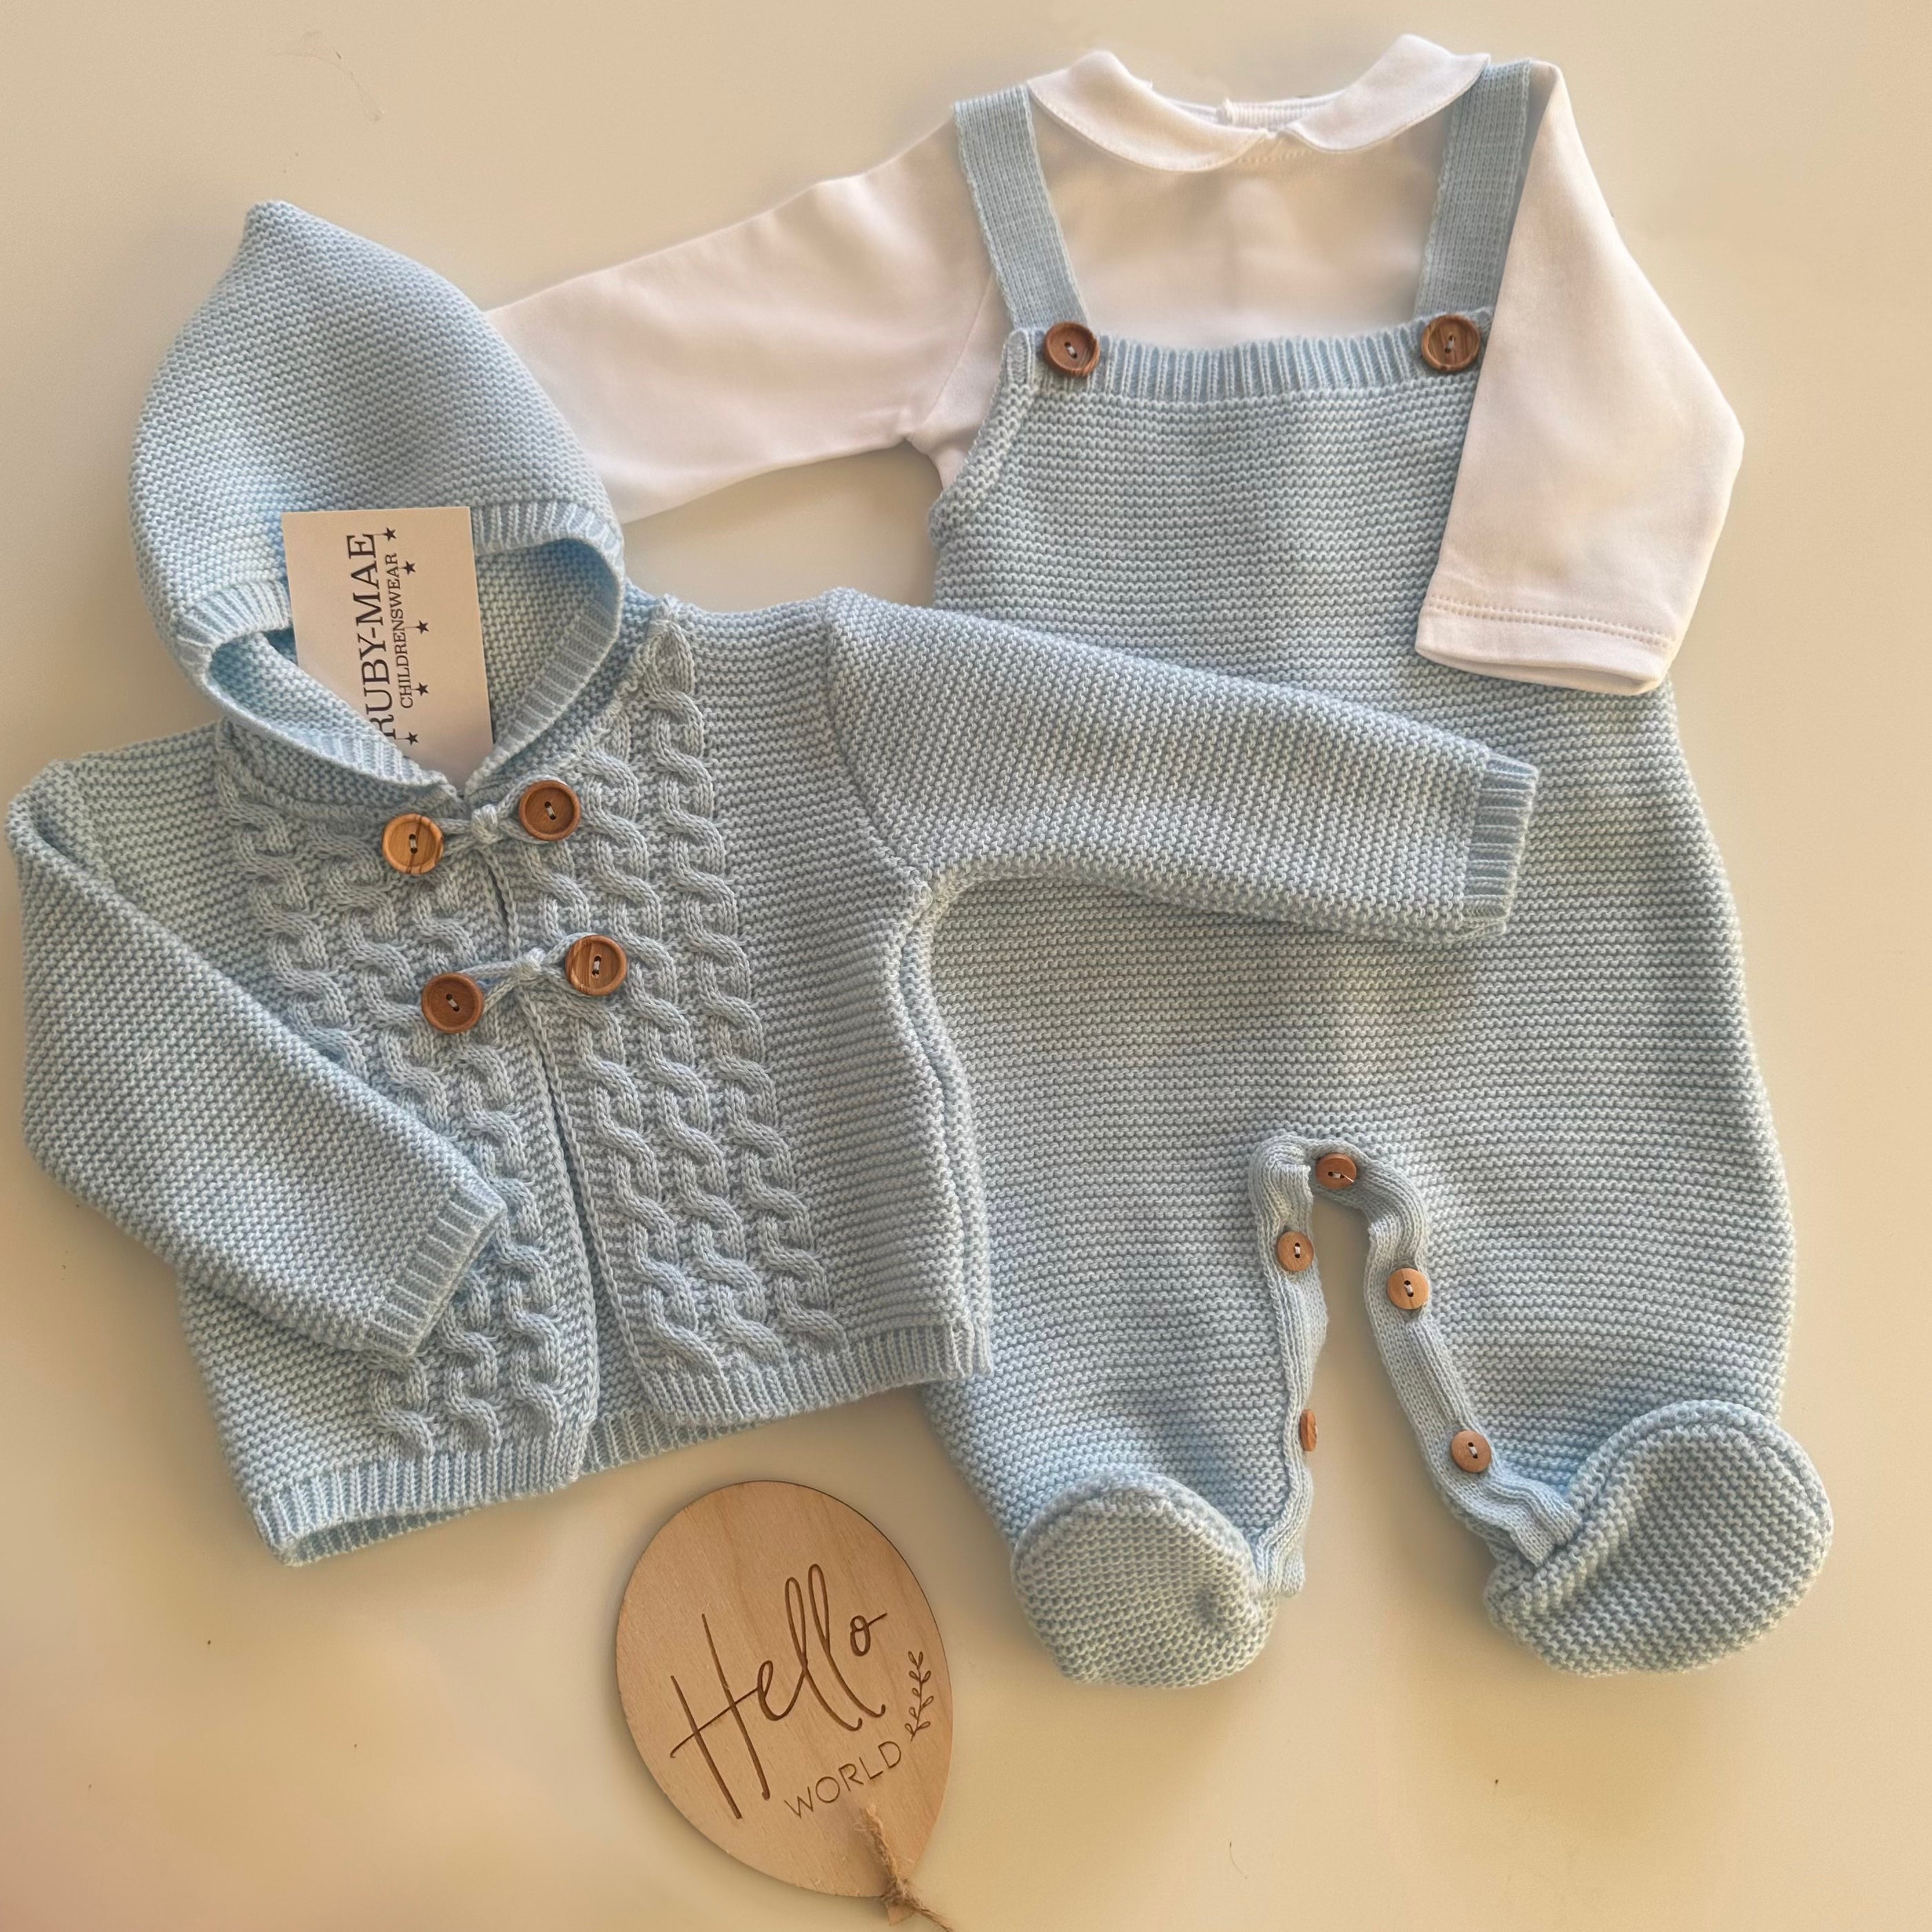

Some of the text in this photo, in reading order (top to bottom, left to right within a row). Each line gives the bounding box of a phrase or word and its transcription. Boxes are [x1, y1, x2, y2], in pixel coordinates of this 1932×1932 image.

[347, 533, 396, 739] RUBY-MAE
[385, 553, 413, 708] CHILDRENSWEAR
[670, 1564, 887, 1819] Hello
[784, 1741, 902, 1819] WORLD
